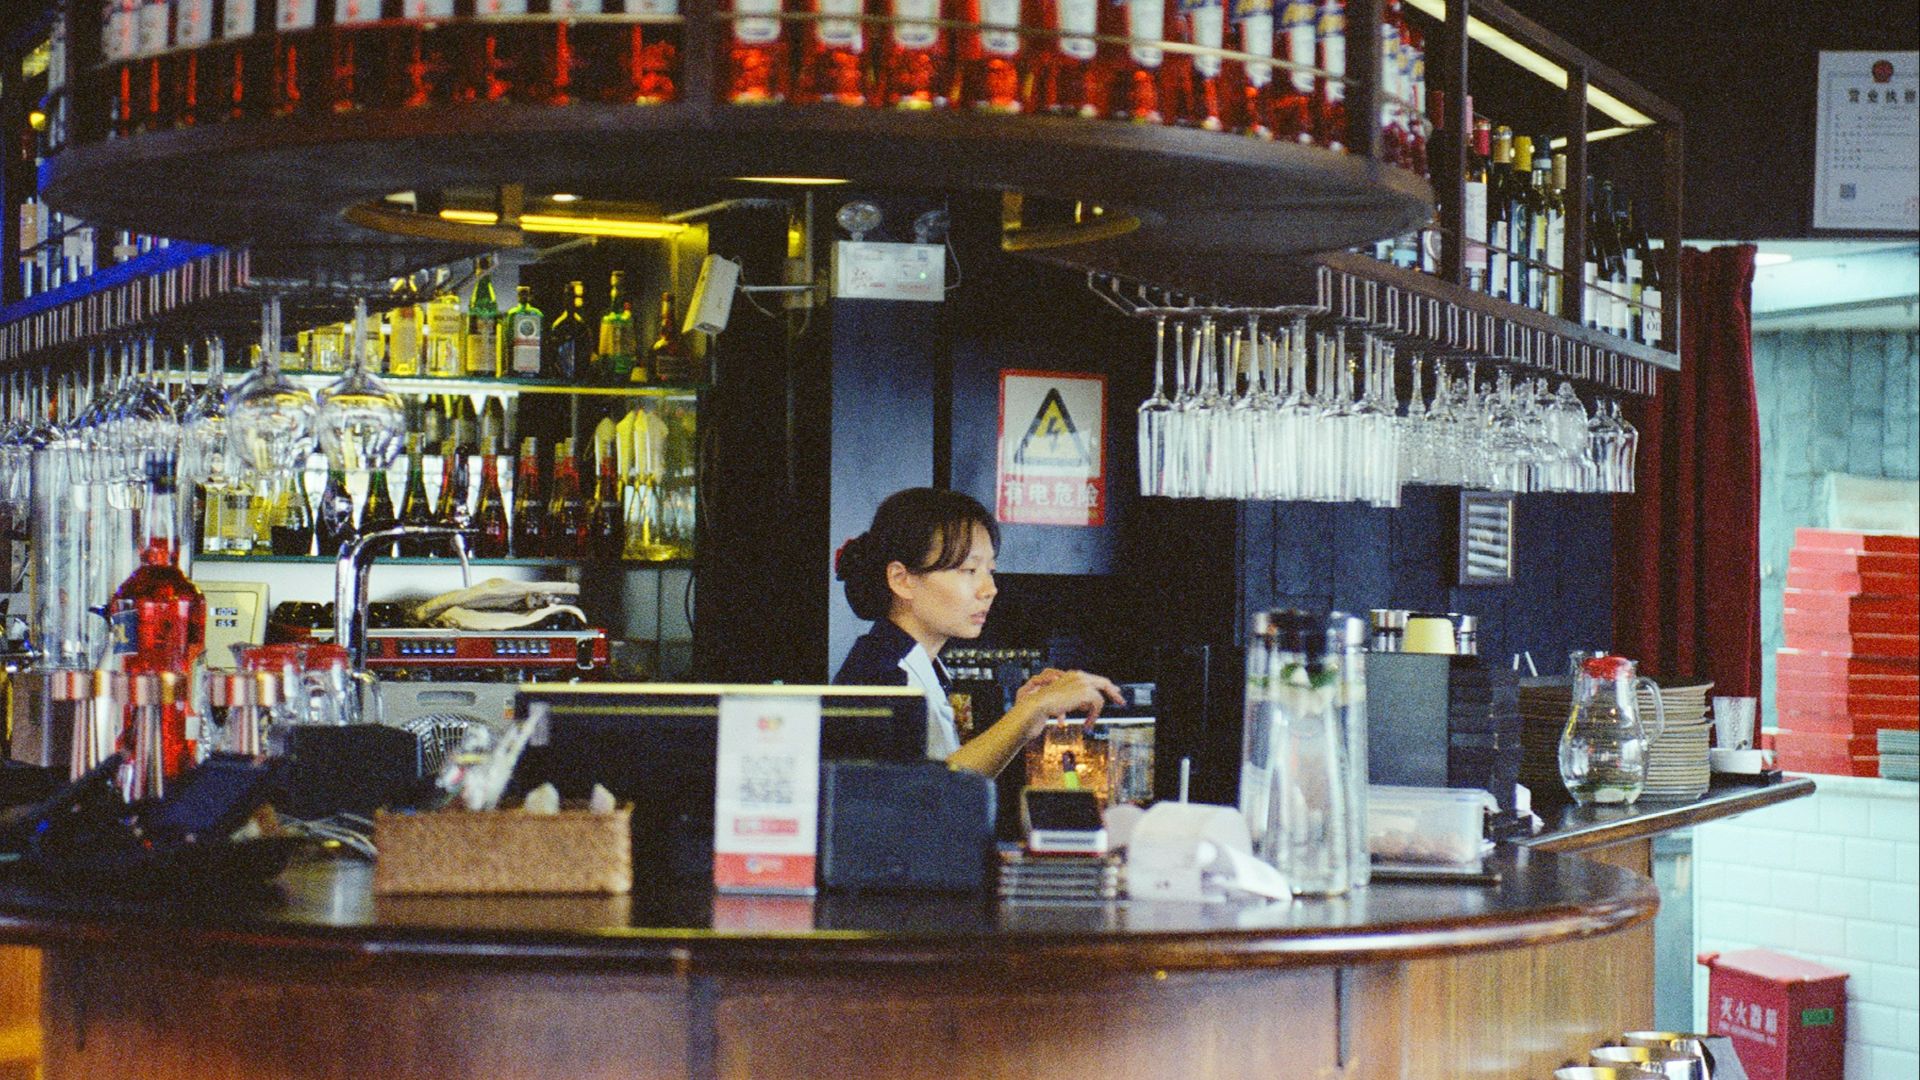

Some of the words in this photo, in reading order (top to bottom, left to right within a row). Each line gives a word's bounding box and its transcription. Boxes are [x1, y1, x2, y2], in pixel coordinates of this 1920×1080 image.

[1848, 88, 1916, 104] 营业执照
[1005, 480, 1099, 507] 有电危险
[1720, 997, 1777, 1033] 灭火器箱
